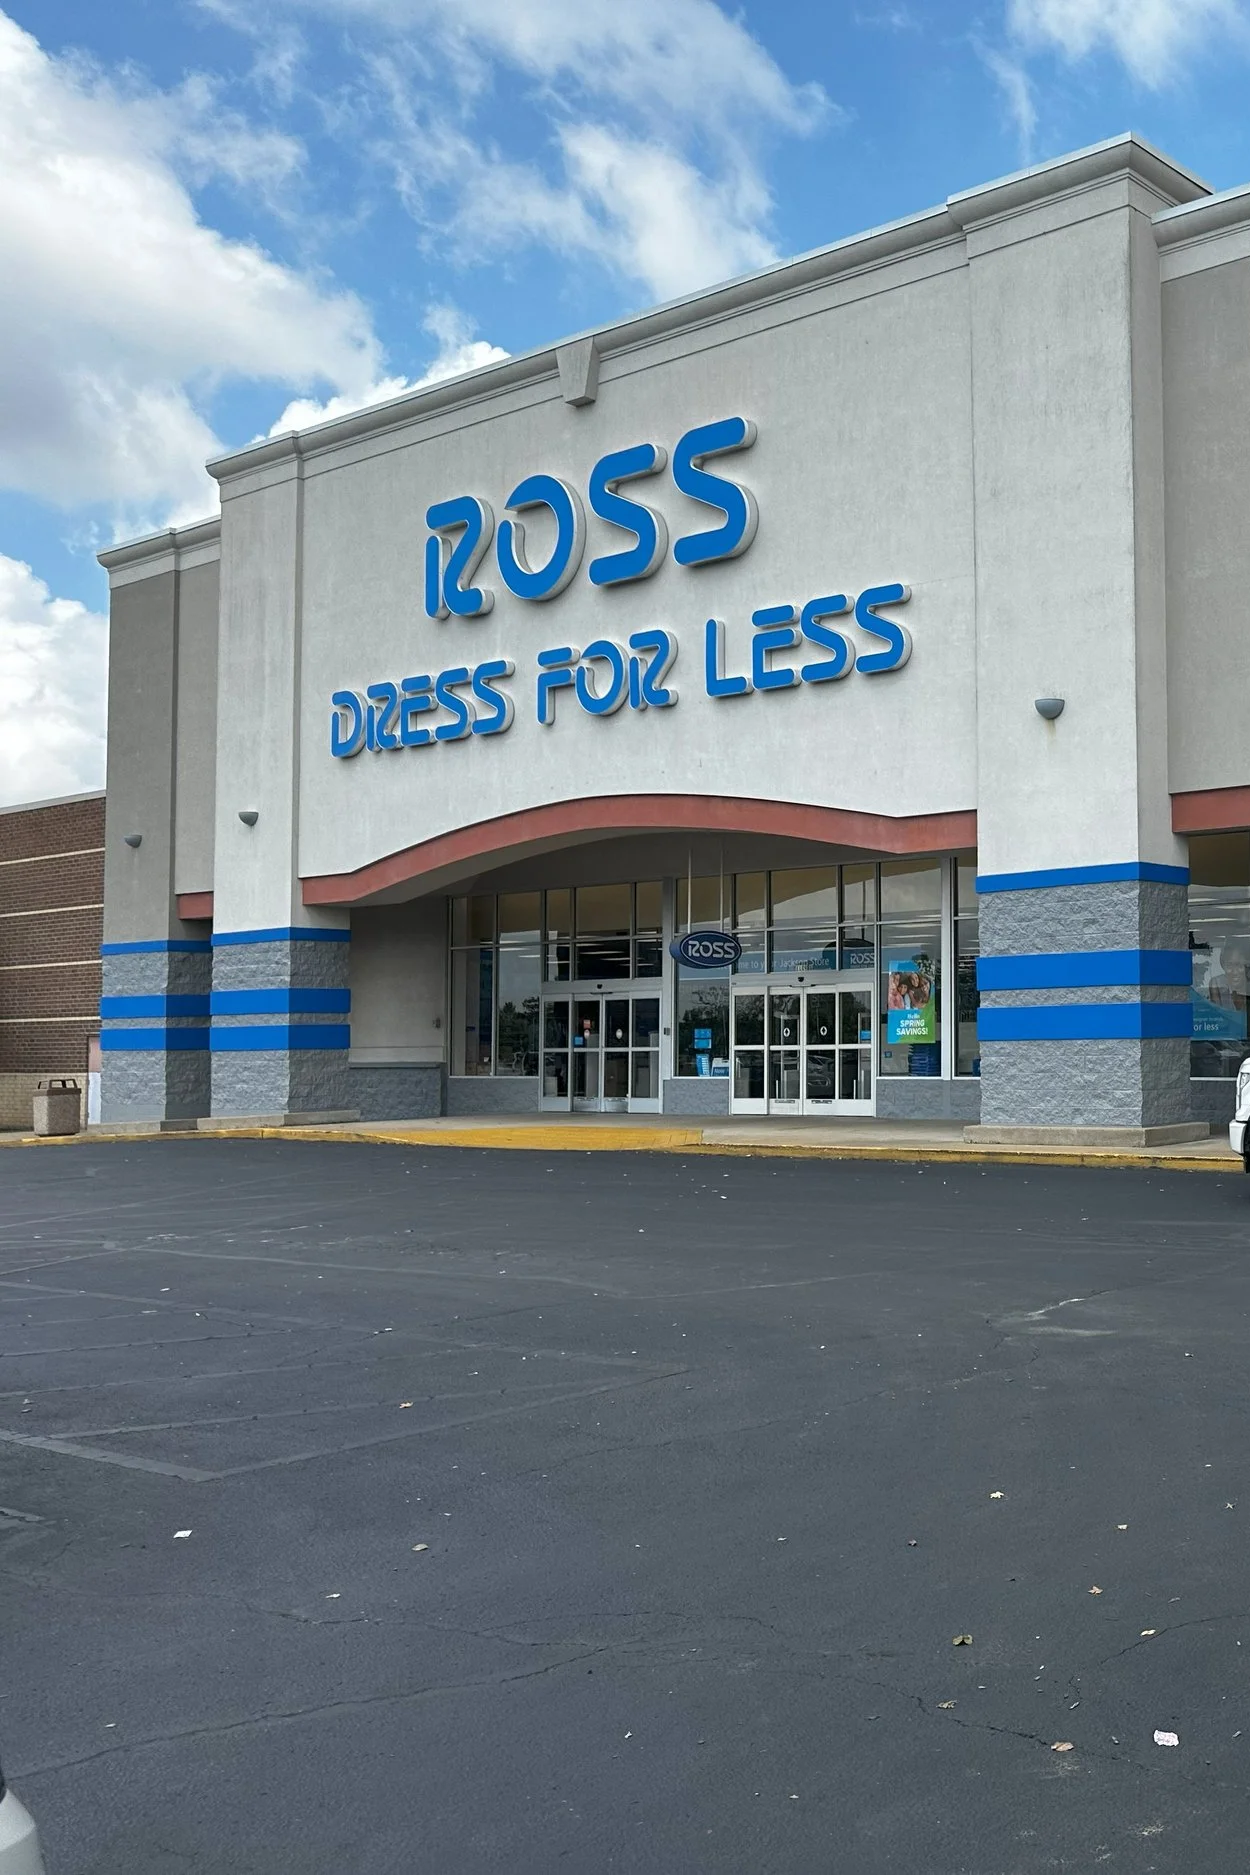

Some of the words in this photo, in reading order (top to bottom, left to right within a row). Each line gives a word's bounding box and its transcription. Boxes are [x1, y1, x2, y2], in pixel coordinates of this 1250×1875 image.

[426, 417, 757, 617] ROSS
[331, 660, 513, 757] DRESS
[538, 630, 678, 724] FOR
[706, 583, 911, 696] LESS
[688, 940, 735, 959] ROSS
[900, 1019, 925, 1028] SPRING
[1203, 1022, 1219, 1031] less
[896, 1027, 928, 1036] SAVINGS!
